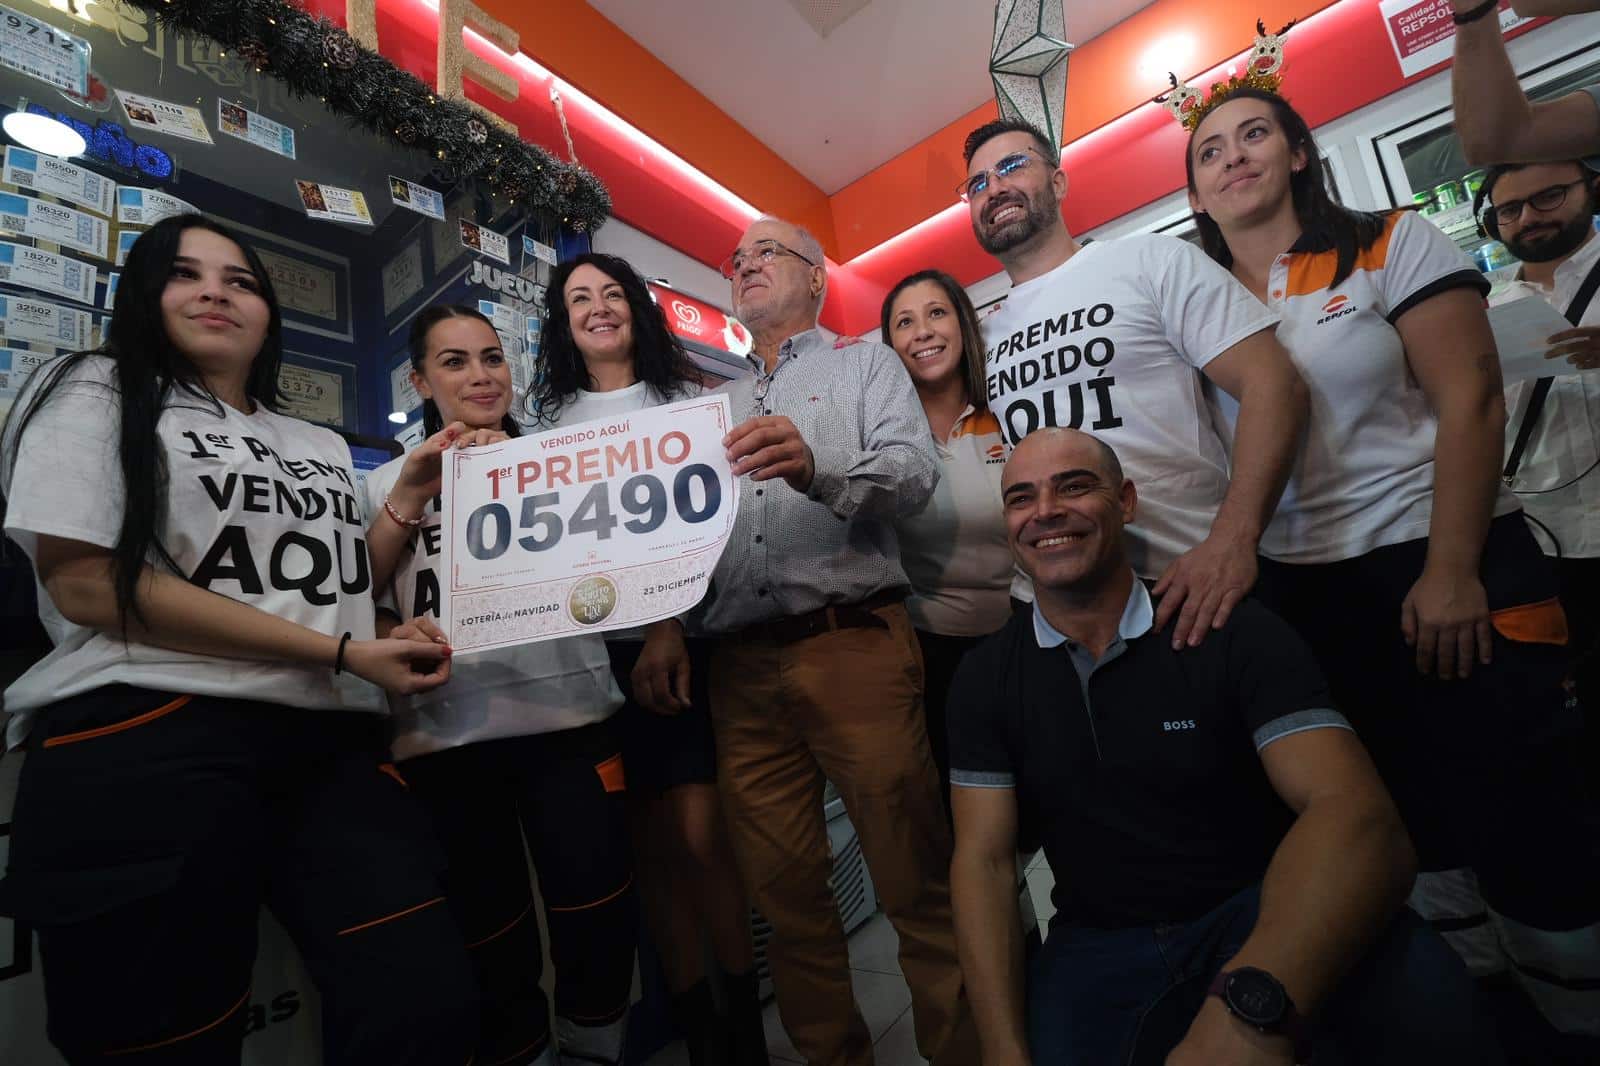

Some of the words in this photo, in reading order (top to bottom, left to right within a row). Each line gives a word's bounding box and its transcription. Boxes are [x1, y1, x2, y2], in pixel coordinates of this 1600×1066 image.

[1398, 2, 1436, 25] Calidad
[1401, 6, 1454, 37] REPSOL
[0, 11, 74, 53] 9712
[36, 204, 70, 219] 06320
[470, 260, 547, 308] JUEVE
[16, 303, 51, 316] 32502
[995, 303, 1115, 364] PREMIO
[986, 337, 1115, 402] ENDIDO
[182, 430, 235, 459] 1er
[540, 429, 596, 450] VENDIDO
[599, 420, 631, 437] AQUÍ
[486, 465, 513, 500] 1er
[516, 430, 692, 494] PREMIO
[198, 472, 362, 526] VENDID
[465, 463, 722, 561] 05490
[188, 525, 370, 606] AQU
[643, 586, 655, 596] 22
[514, 603, 560, 617] NAVIDAD
[1163, 719, 1196, 731] BOSS
